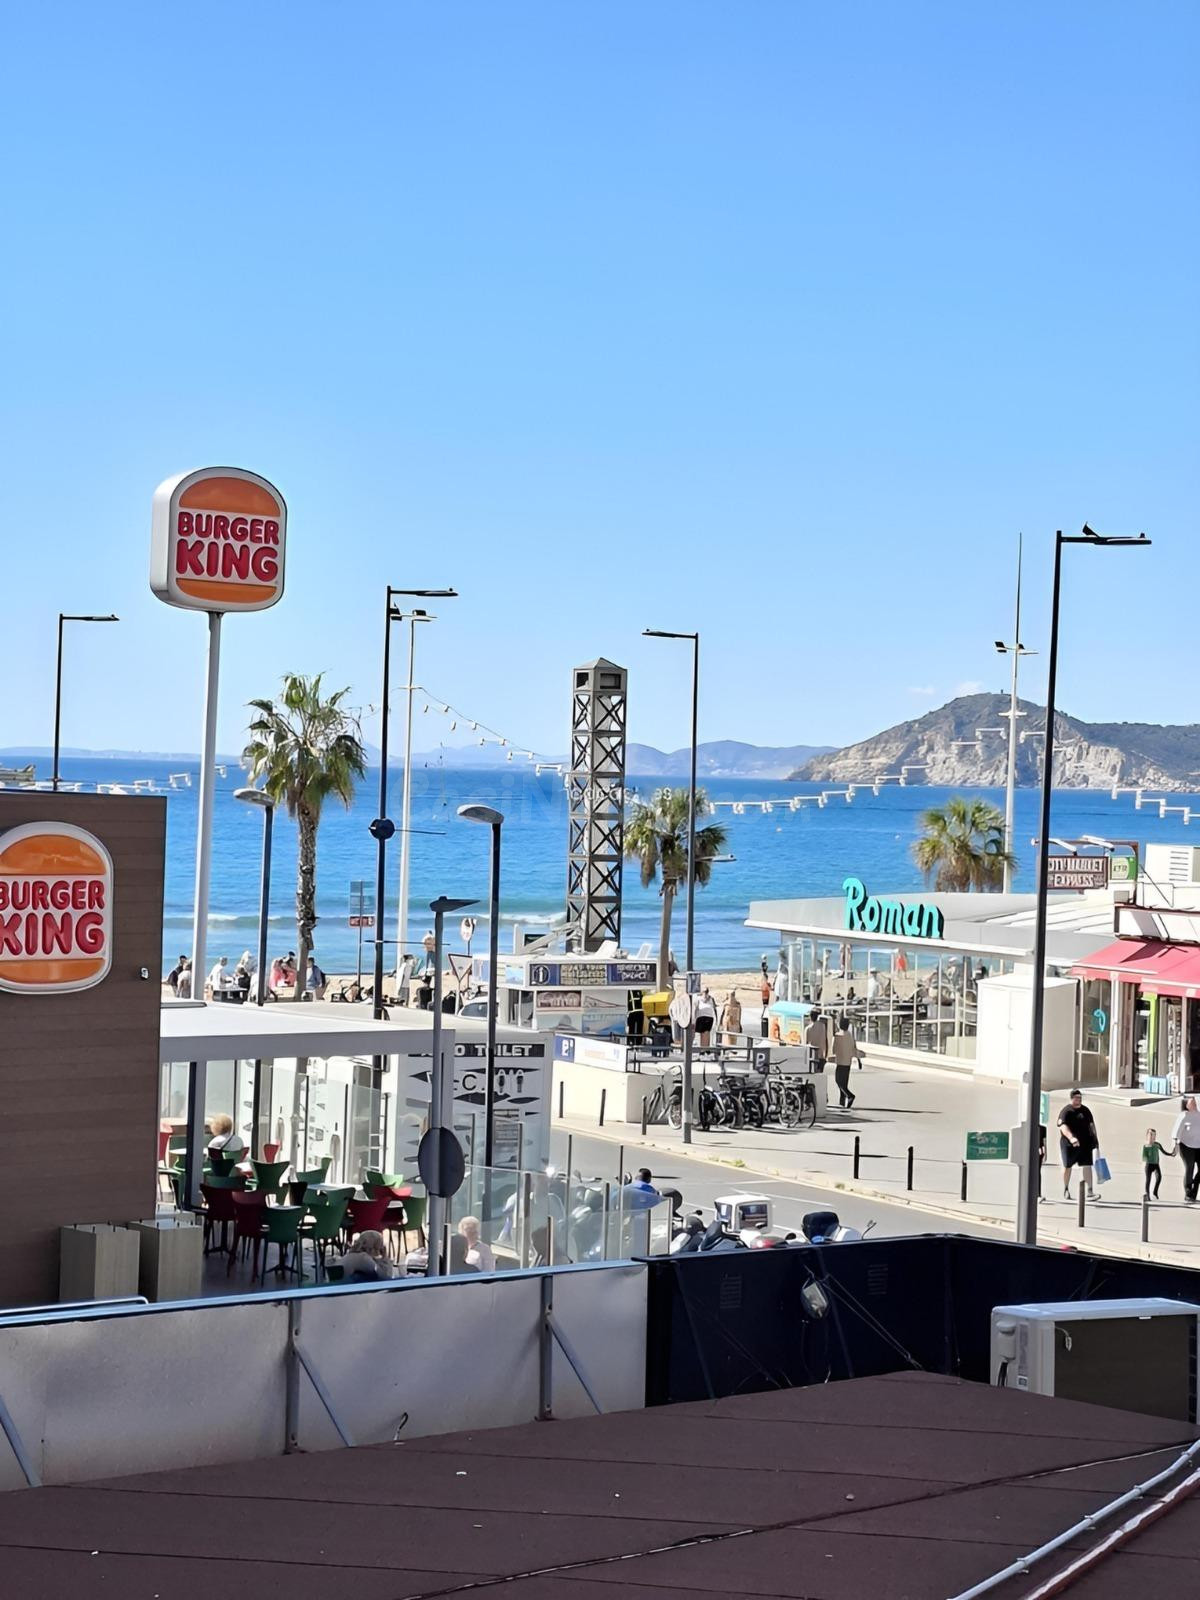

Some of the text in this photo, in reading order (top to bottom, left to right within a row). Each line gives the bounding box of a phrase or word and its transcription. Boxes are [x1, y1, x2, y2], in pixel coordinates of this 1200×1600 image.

[178, 511, 279, 545] BURGER
[176, 538, 279, 582] KING
[842, 877, 943, 939] Roman
